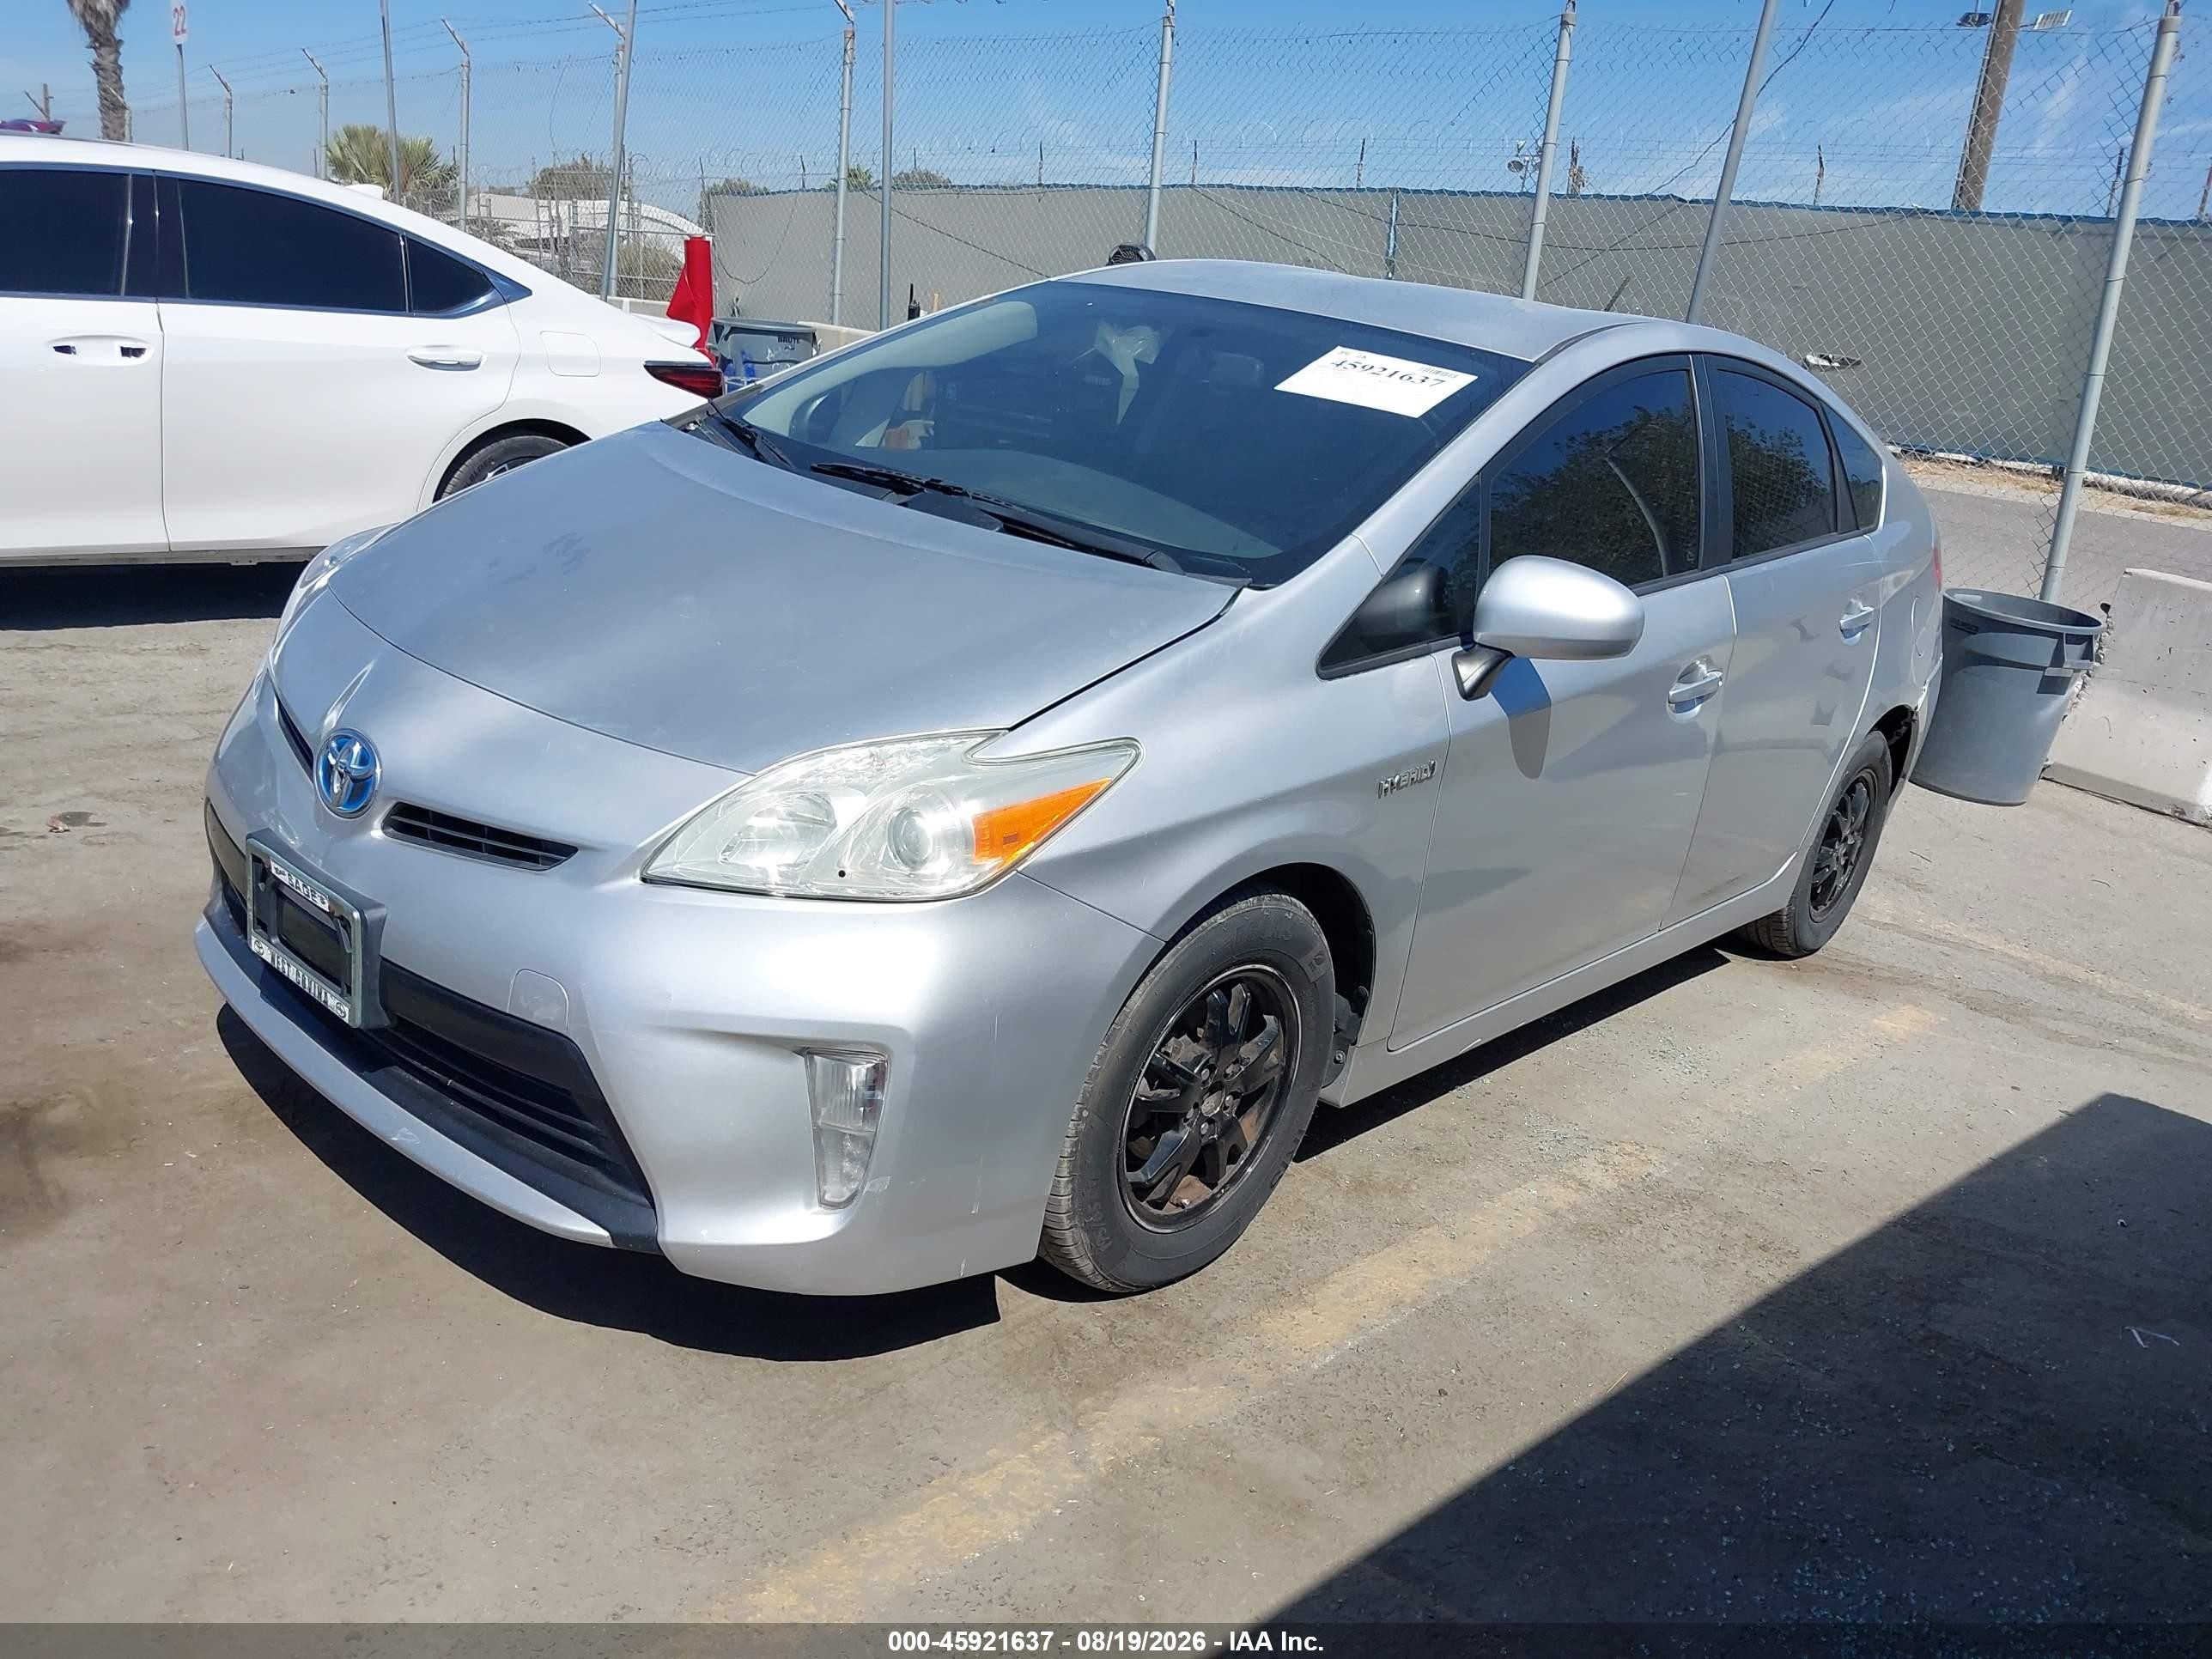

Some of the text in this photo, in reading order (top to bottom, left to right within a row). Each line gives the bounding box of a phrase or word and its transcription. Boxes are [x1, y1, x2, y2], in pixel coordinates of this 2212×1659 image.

[173, 5, 186, 36] 22
[1331, 360, 1446, 386] 45921637
[269, 950, 329, 1006] WEST COVINA
